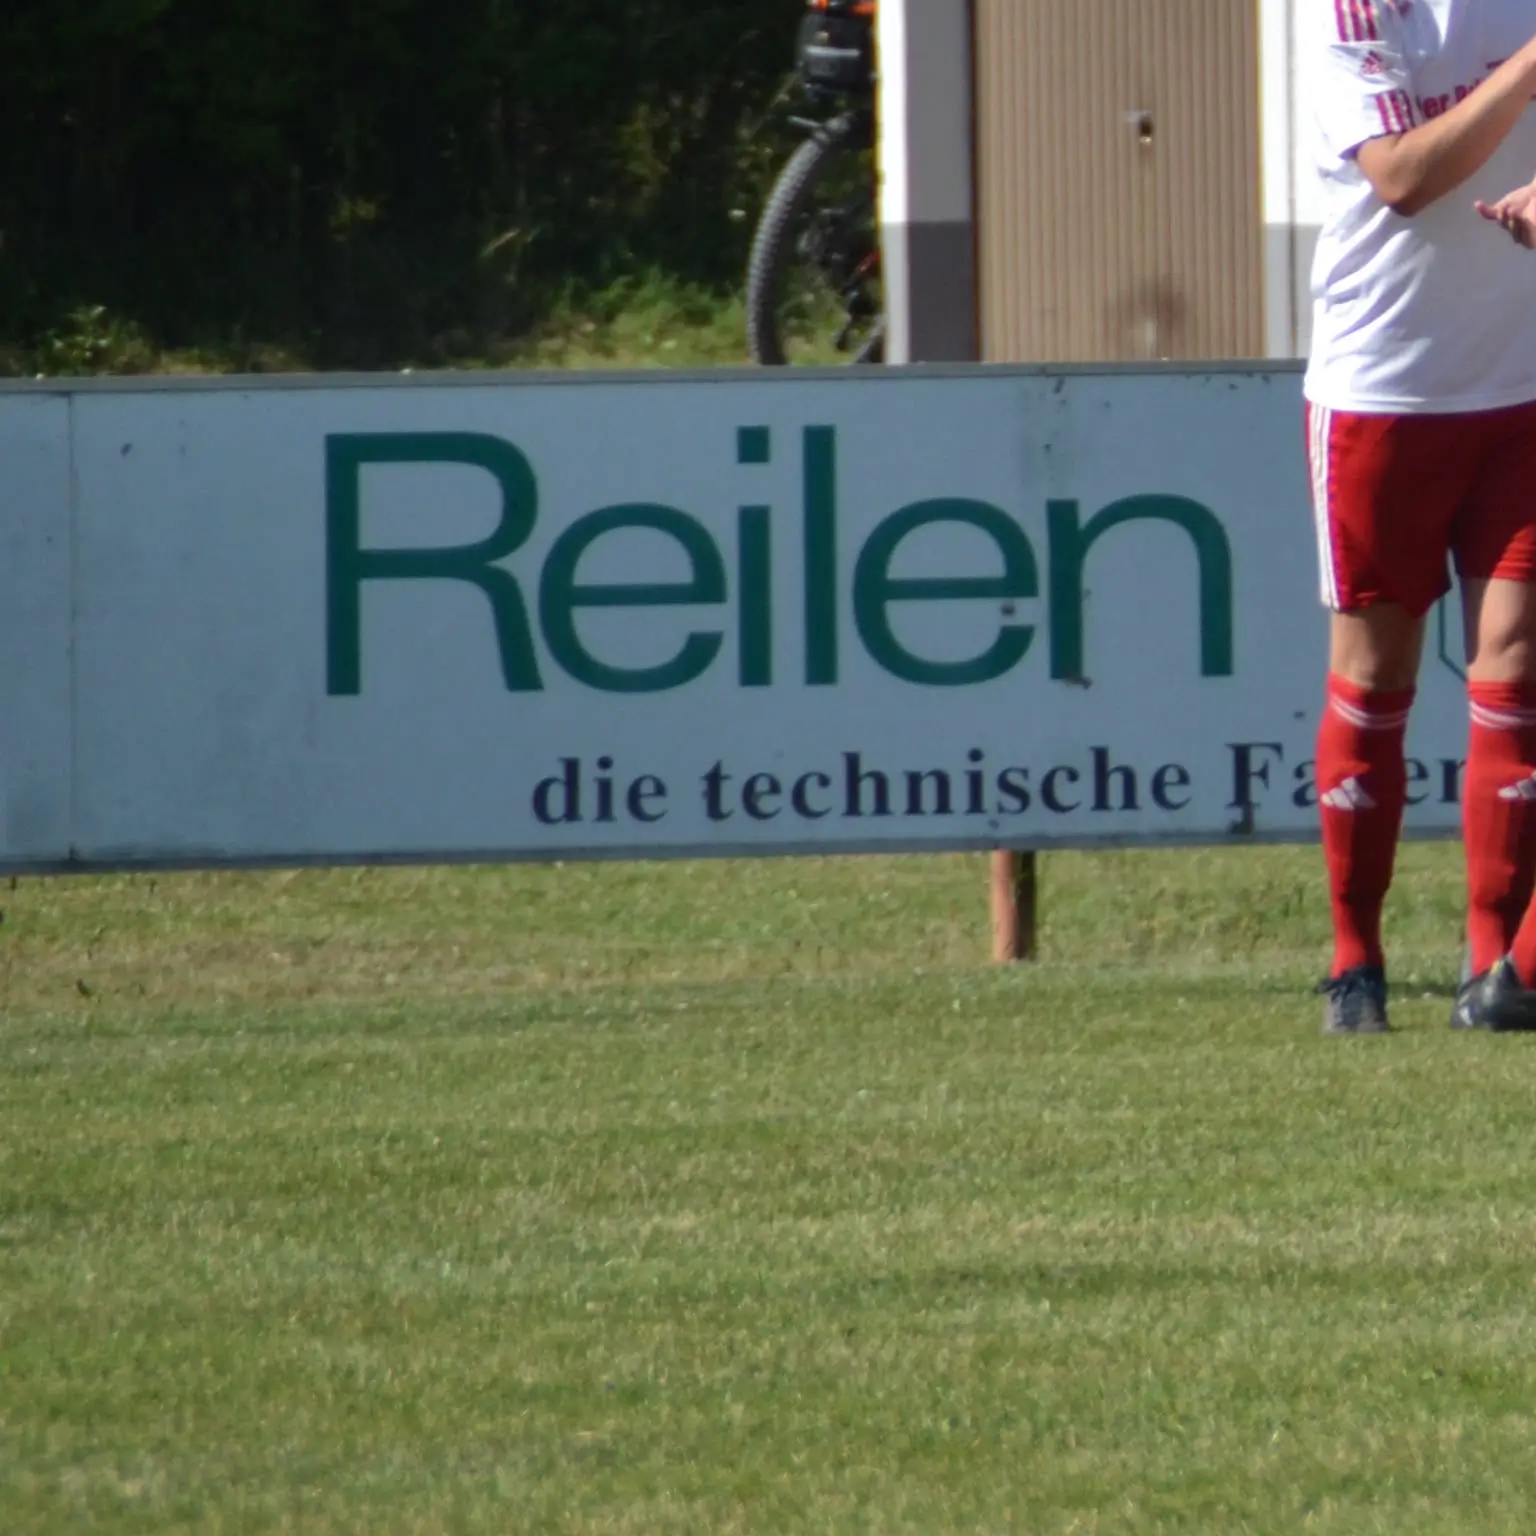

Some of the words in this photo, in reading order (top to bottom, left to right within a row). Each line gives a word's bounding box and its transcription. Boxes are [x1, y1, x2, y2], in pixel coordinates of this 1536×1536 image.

[324, 424, 1233, 696] Reilen
[532, 756, 669, 826] die
[701, 745, 1190, 822] technische
[1225, 740, 1468, 810] Faer
